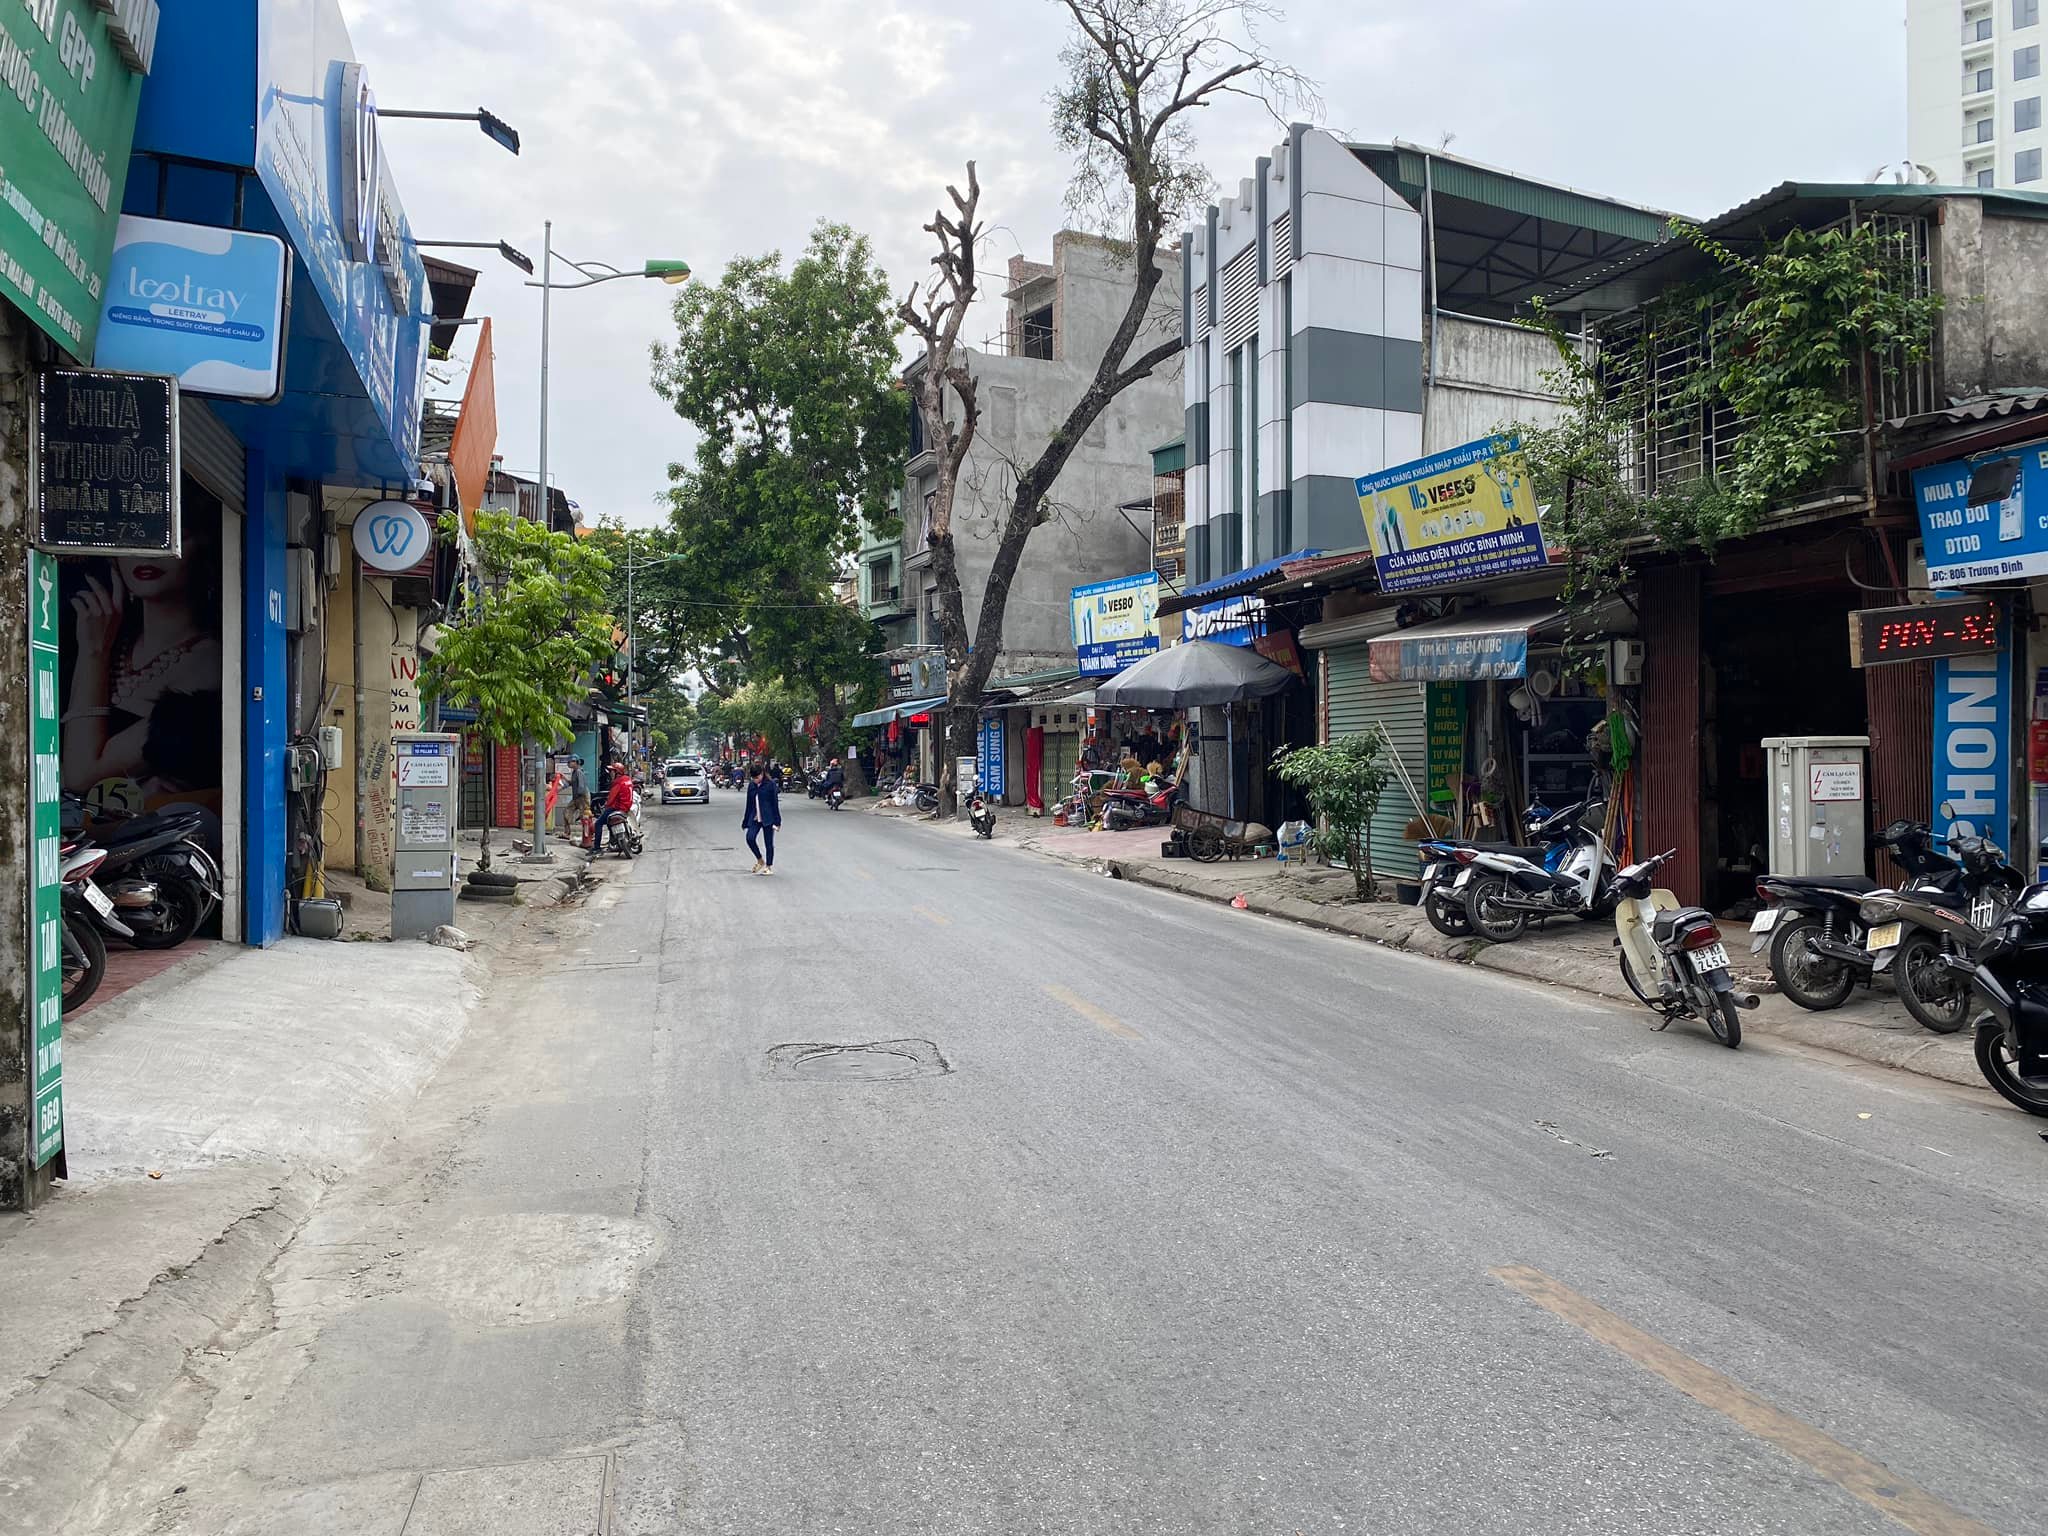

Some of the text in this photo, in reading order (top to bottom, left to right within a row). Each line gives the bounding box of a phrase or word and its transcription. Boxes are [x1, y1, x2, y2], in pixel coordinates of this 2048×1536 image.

[59, 10, 95, 94] GPP
[38, 84, 82, 172] THÀNH
[168, 308, 208, 320] LEETRAY
[1923, 484, 1954, 503] MUA
[1928, 509, 1963, 530] TRAO
[1406, 550, 1430, 567] HÀNG
[1450, 541, 1476, 558] NƯỚC
[1477, 535, 1499, 551] BÌNH
[1499, 531, 1525, 546] MINH
[1945, 534, 1981, 555] ĐTDĐ
[1950, 566, 1966, 580] 806
[2001, 560, 2024, 576] Định
[1108, 596, 1134, 612] VESBO
[39, 660, 55, 720] NHÀ
[35, 736, 59, 803] THUỐC
[990, 731, 1001, 790] SAM SUNG
[1946, 653, 1998, 863] PHON
[38, 826, 59, 889] NHÂN
[41, 911, 57, 973] TÂM
[1699, 956, 1727, 973] 2454
[41, 1096, 59, 1135] 669
